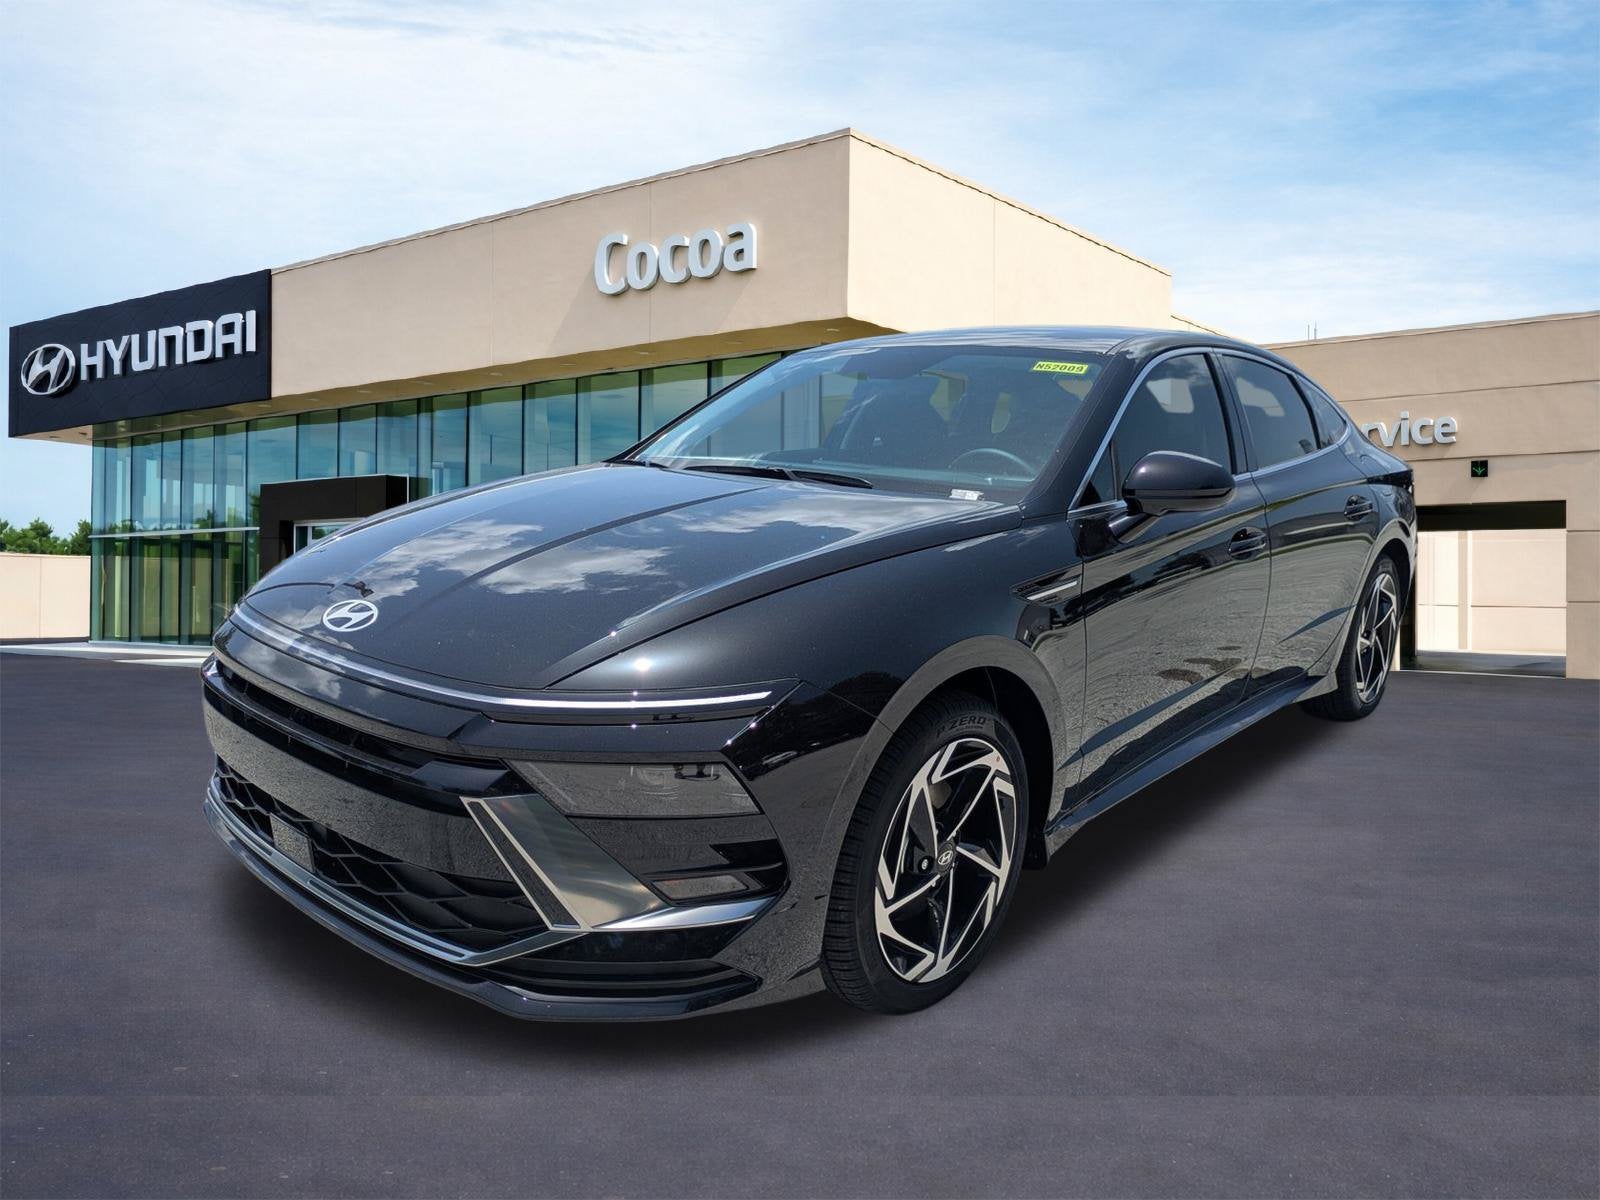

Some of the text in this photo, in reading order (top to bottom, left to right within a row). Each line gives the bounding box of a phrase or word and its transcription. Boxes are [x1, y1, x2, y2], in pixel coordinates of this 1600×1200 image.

[594, 222, 758, 296] Cocoa
[80, 309, 257, 381] HYUNDAI
[1035, 363, 1085, 373] N52009
[1360, 410, 1459, 448] rvice
[949, 715, 988, 730] ZERO
